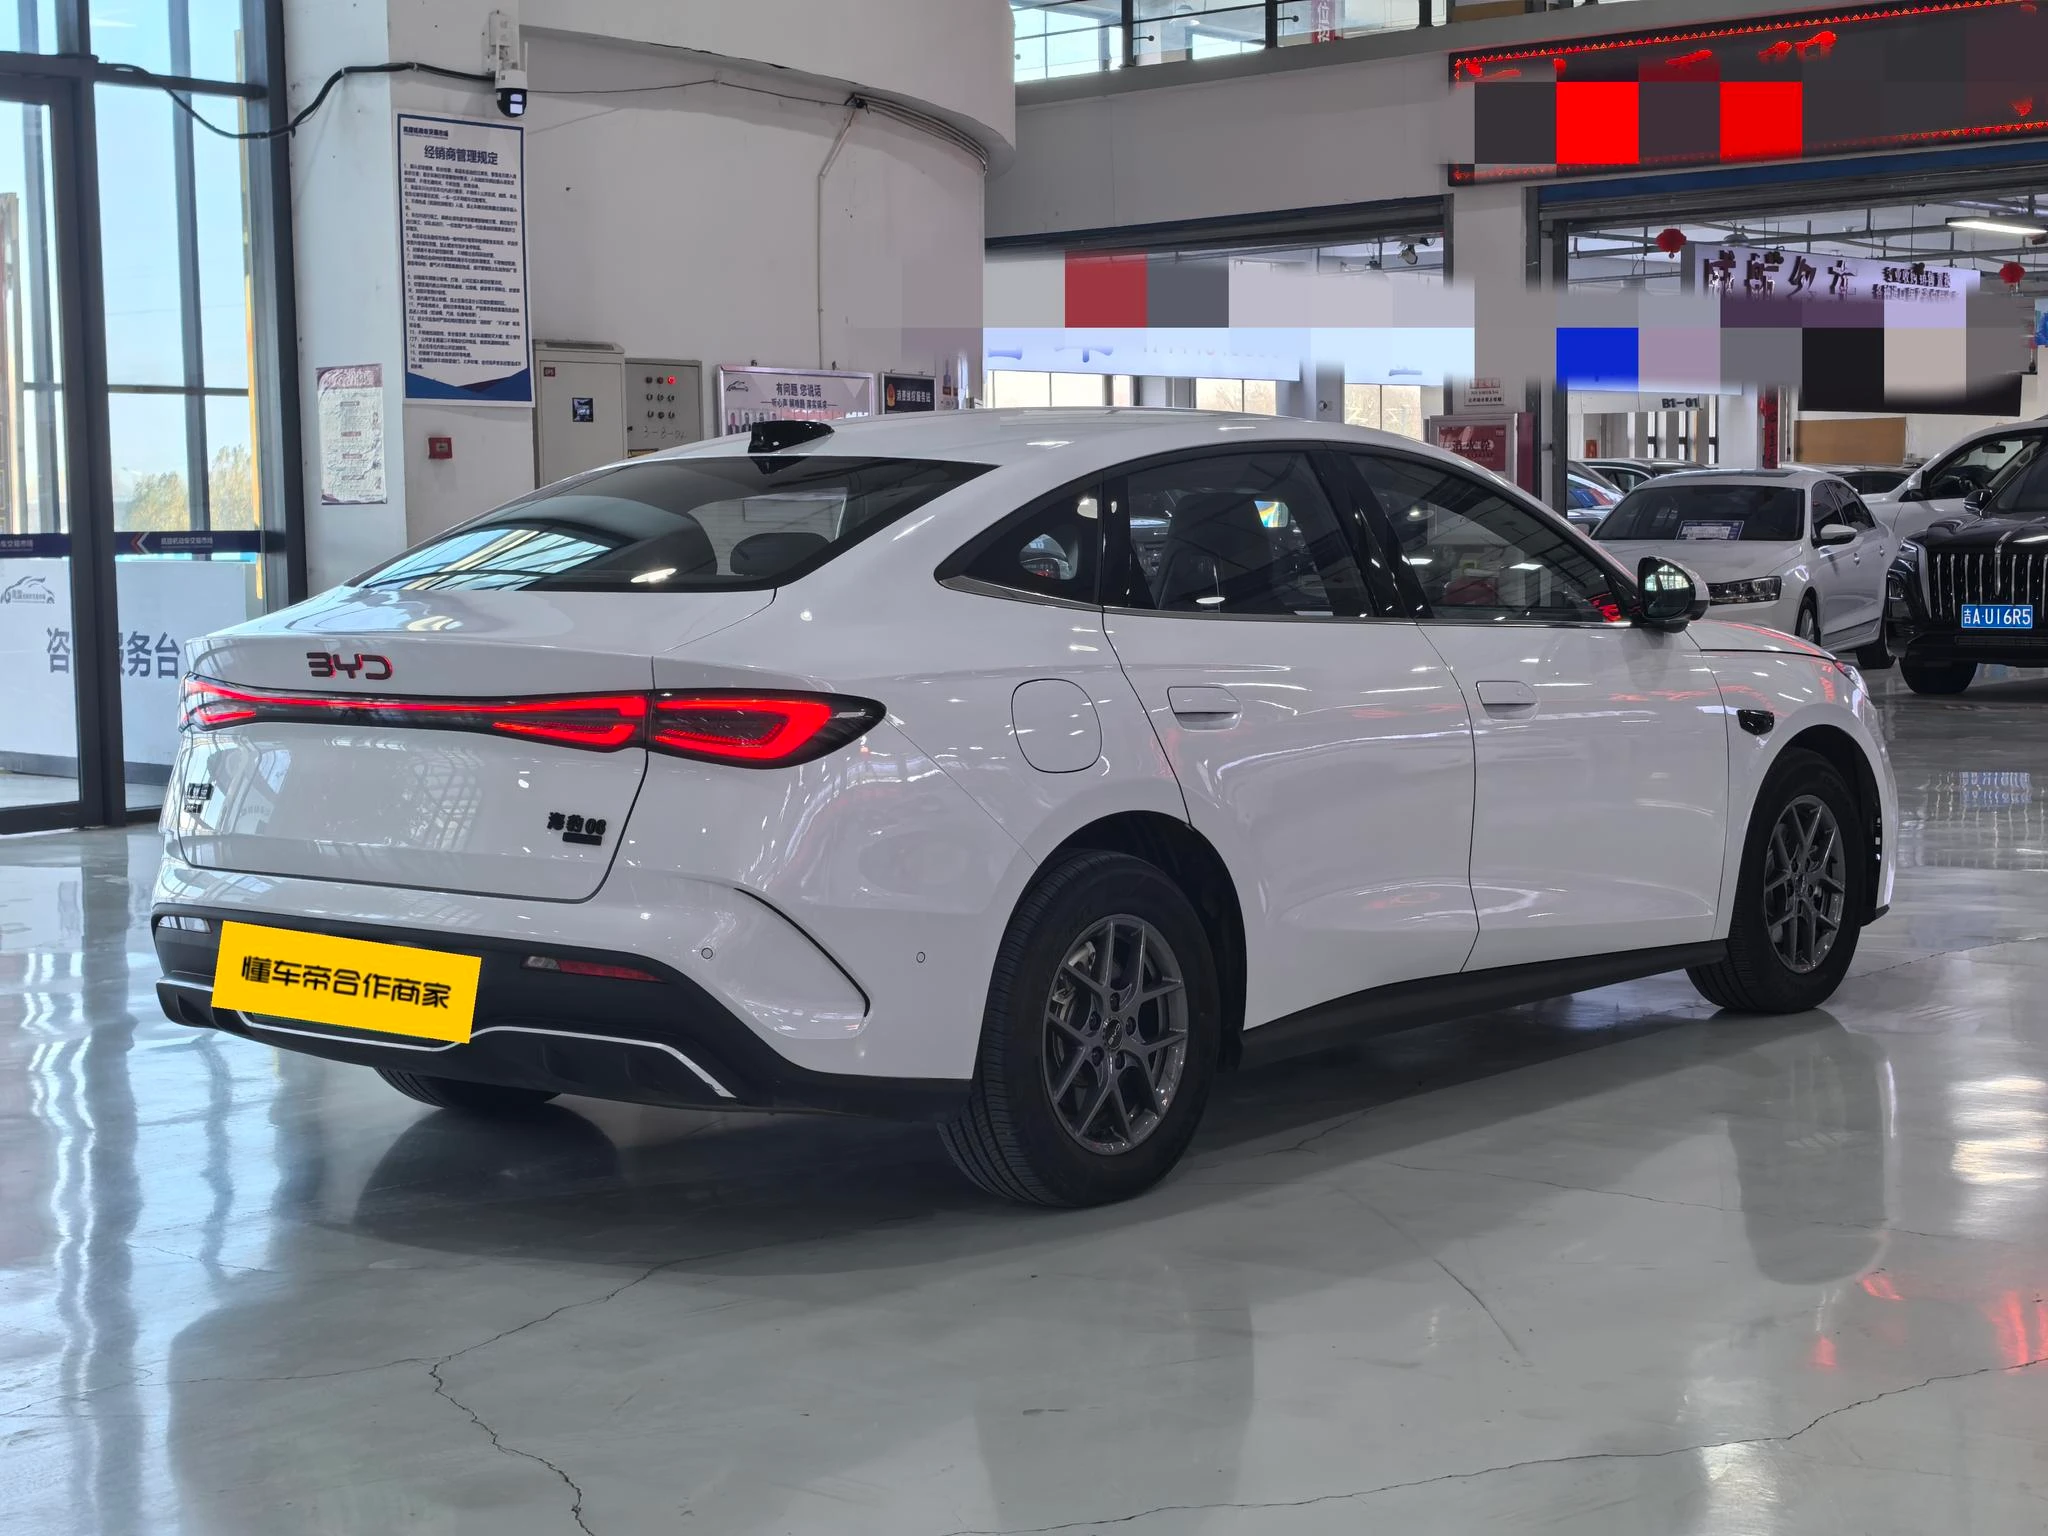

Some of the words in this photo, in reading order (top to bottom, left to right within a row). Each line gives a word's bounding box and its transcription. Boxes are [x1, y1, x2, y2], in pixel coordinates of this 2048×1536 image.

[424, 145, 498, 165] 经销商管理规定
[776, 382, 799, 397] 有问题
[800, 384, 822, 398] 您说话
[1662, 398, 1698, 408] B1-01
[306, 651, 393, 681] BYD
